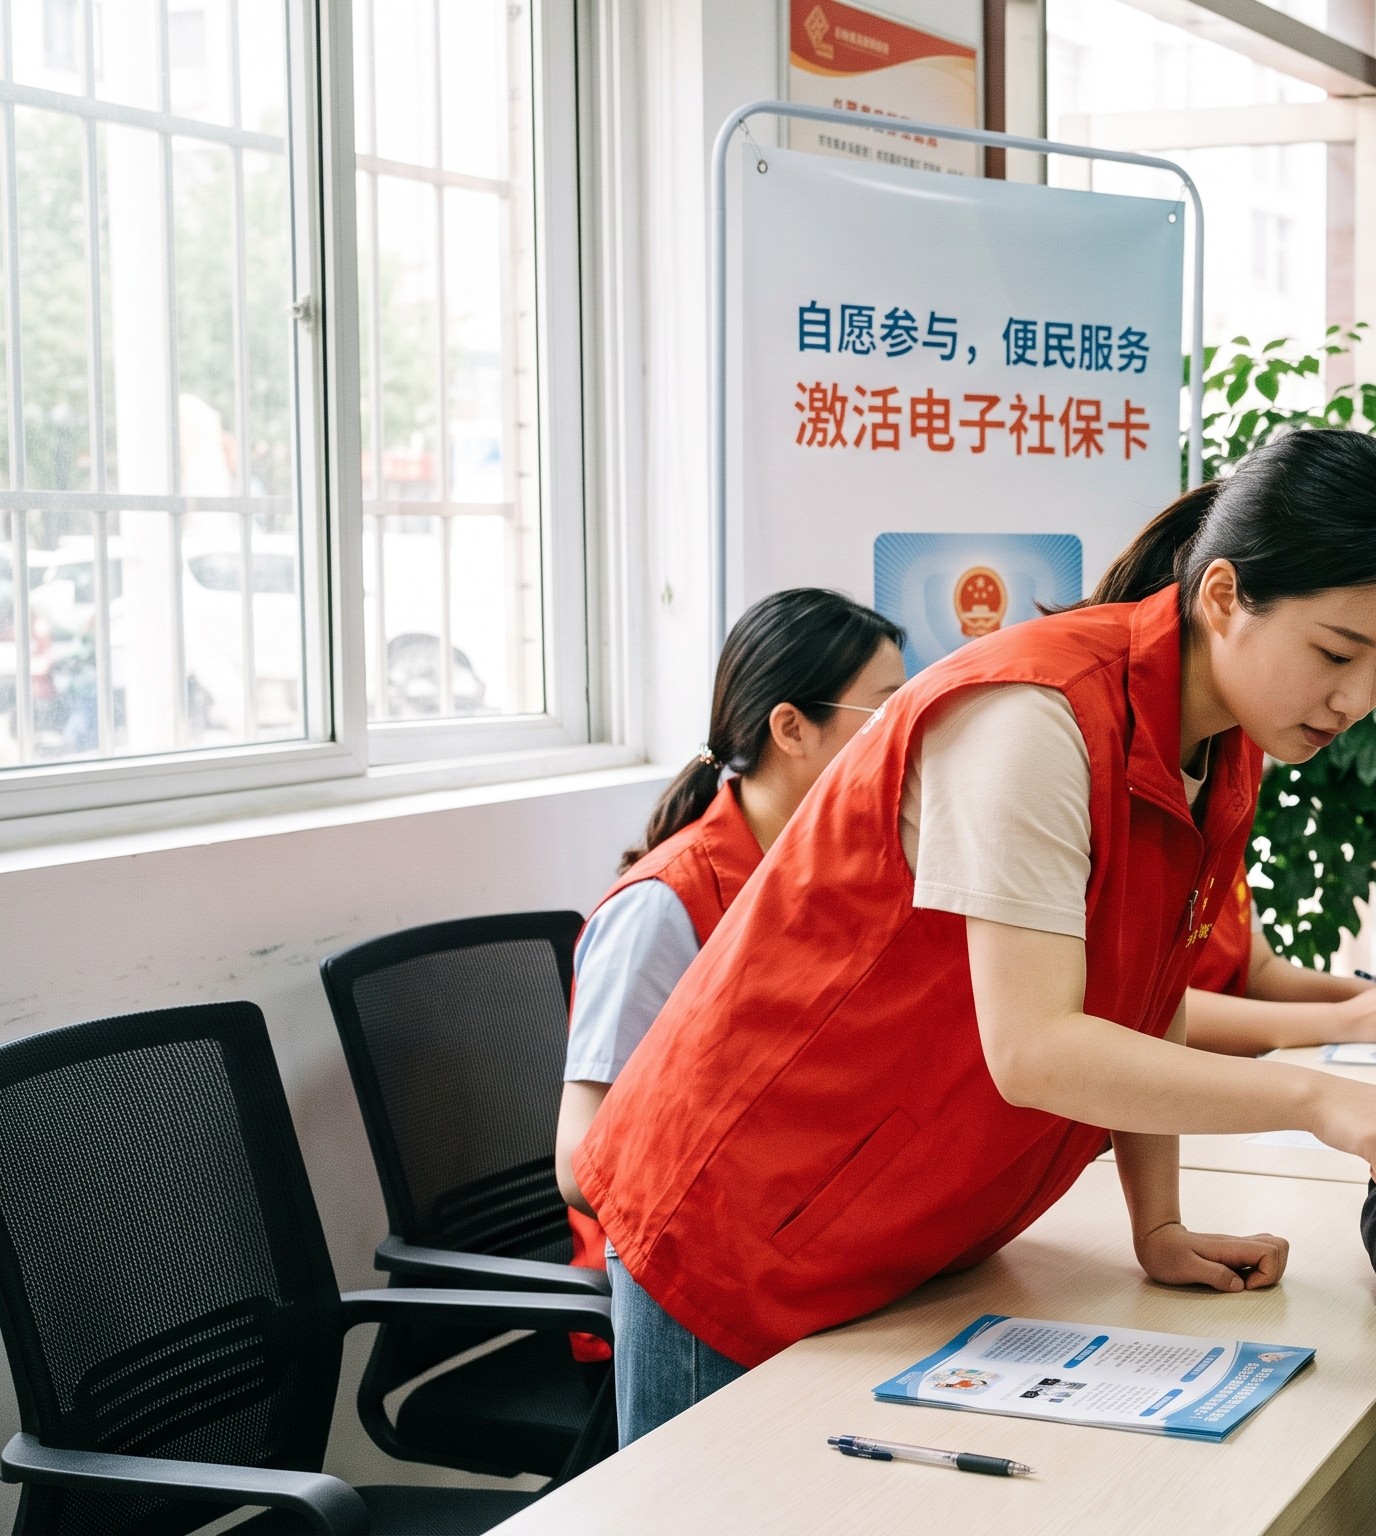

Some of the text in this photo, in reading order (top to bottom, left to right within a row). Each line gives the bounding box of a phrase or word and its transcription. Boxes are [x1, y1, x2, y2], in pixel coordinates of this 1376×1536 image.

[798, 300, 1151, 374] 自愿参与，便民服务
[794, 380, 1151, 460] 激活电子社保卡
